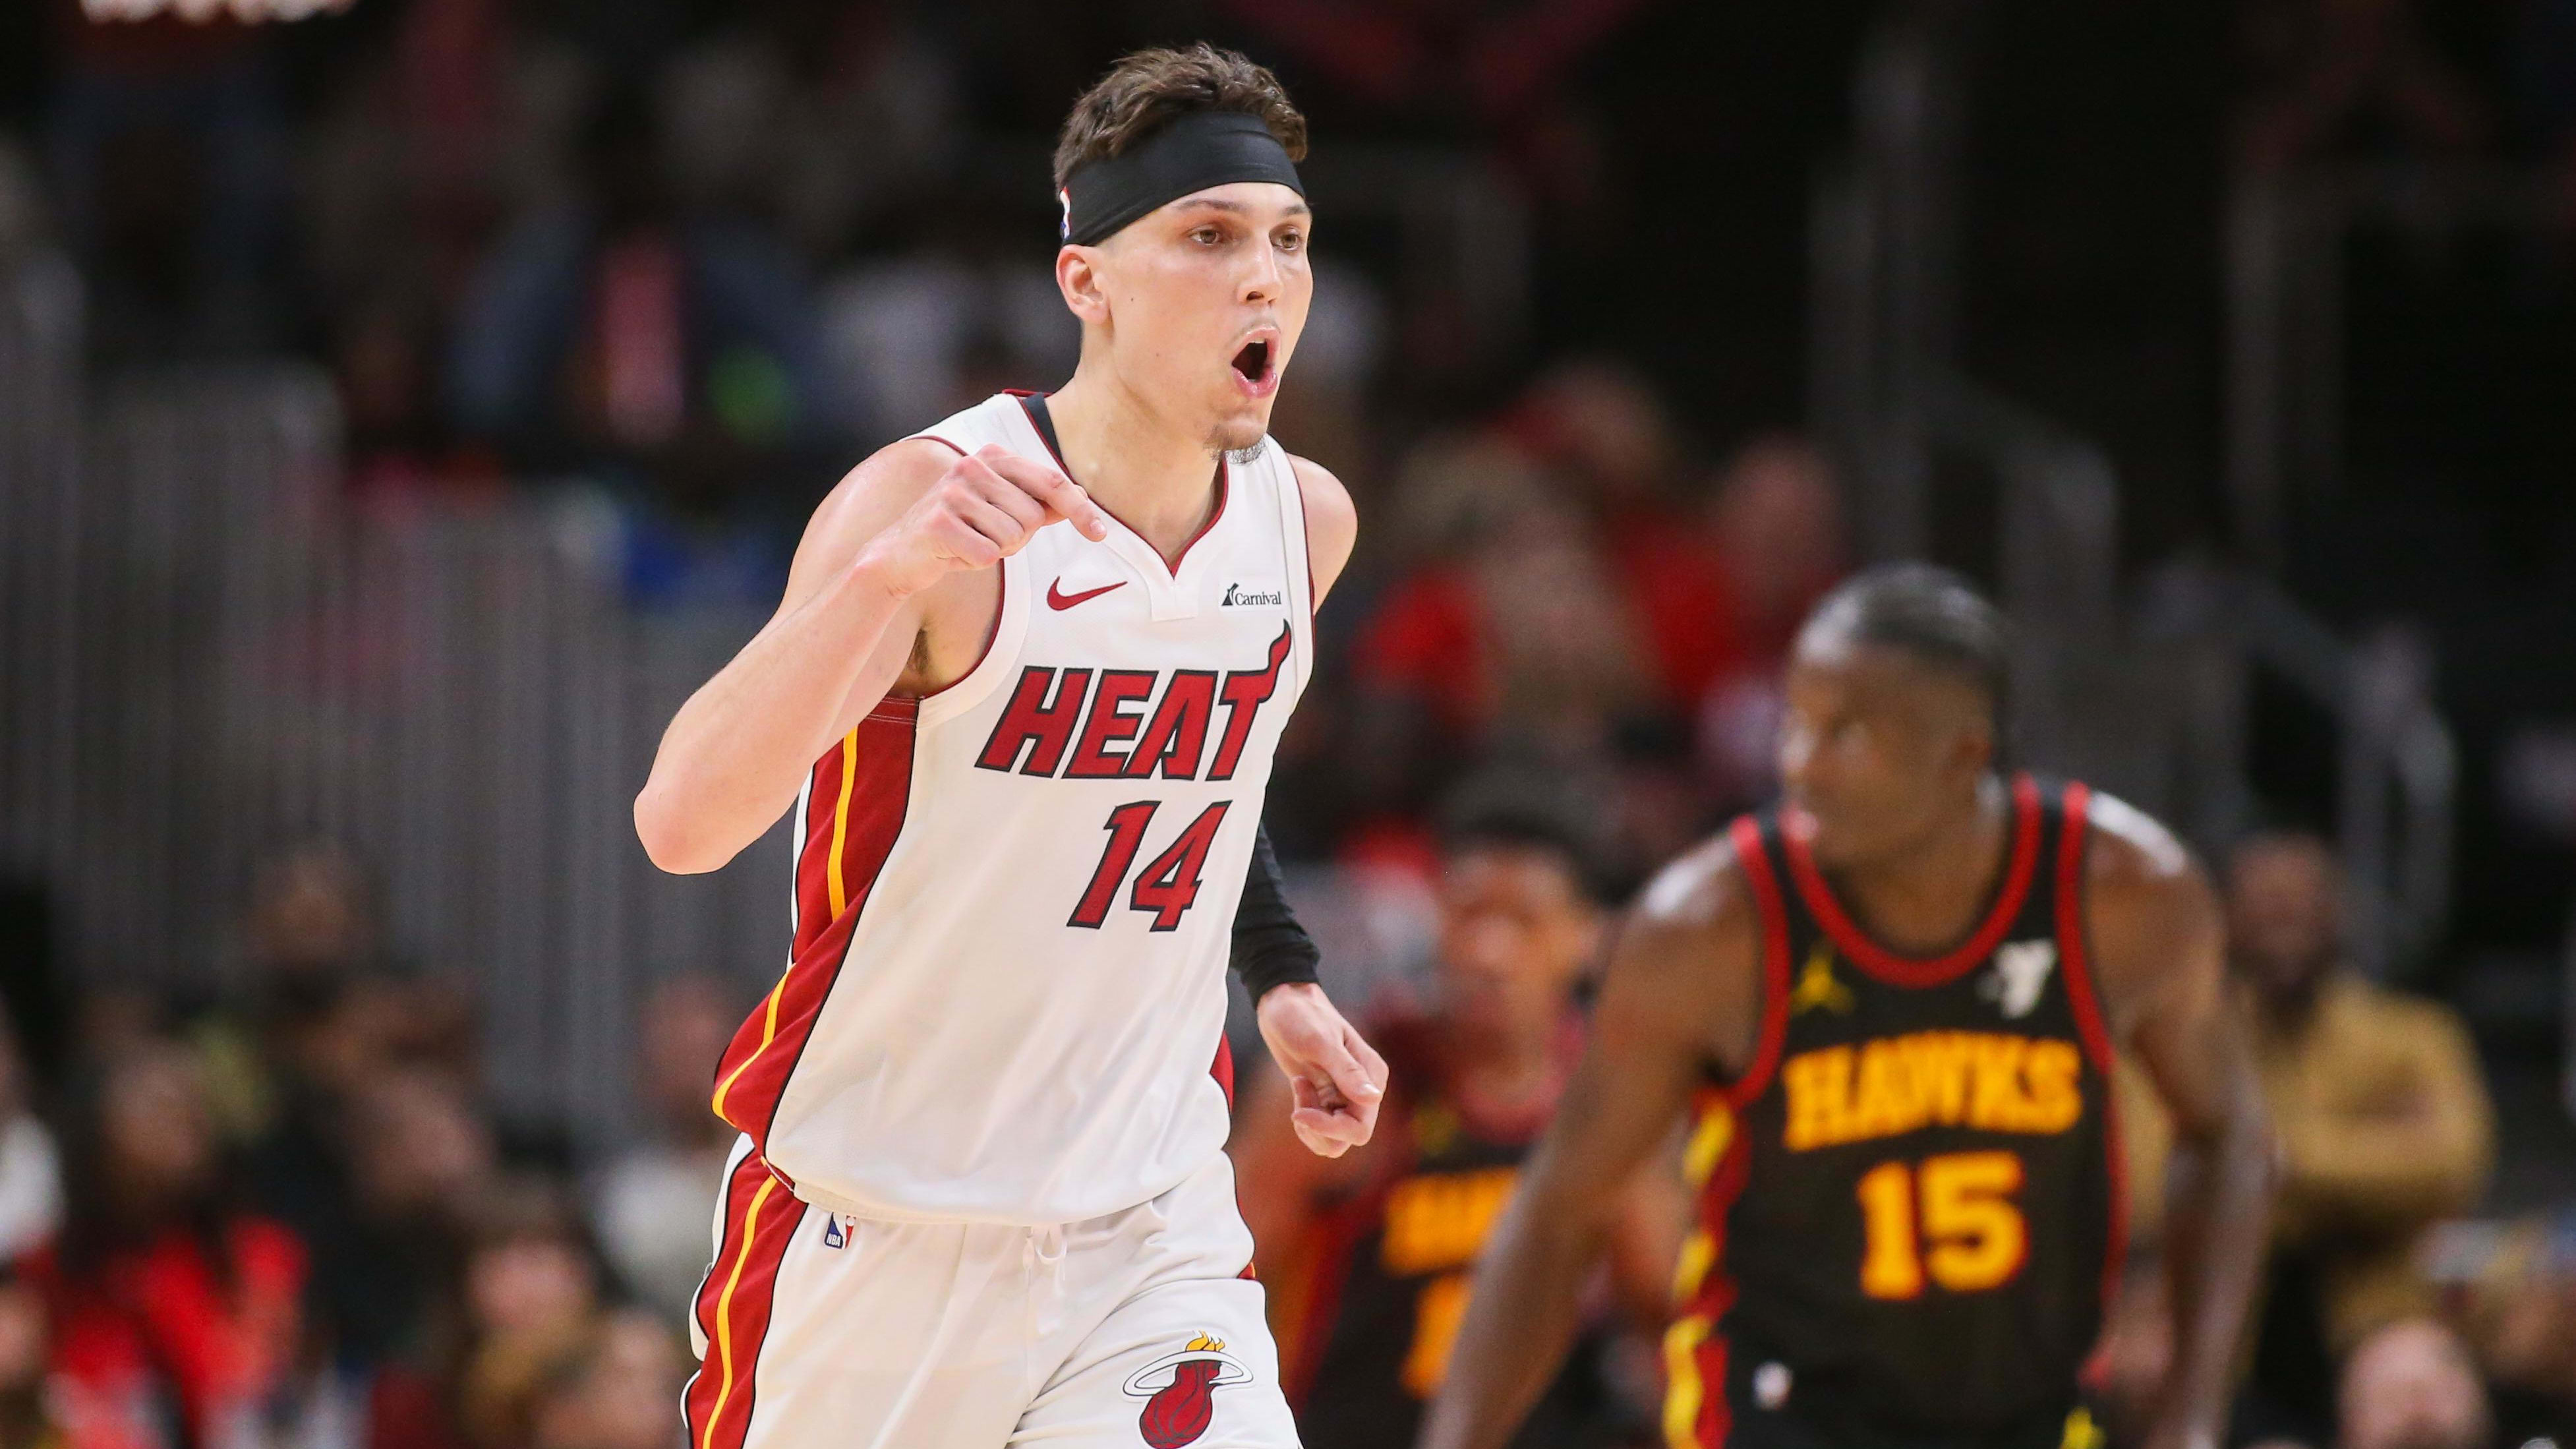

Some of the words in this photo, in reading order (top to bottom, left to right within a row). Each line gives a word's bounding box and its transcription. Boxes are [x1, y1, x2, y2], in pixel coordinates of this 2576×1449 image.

[1235, 591, 1281, 606] Carnival
[974, 618, 1292, 781] HEAT
[1067, 800, 1233, 932] 14
[1782, 1030, 2082, 1152] HAWKS
[826, 1233, 842, 1247] NBA
[1858, 1151, 2028, 1300] 15
